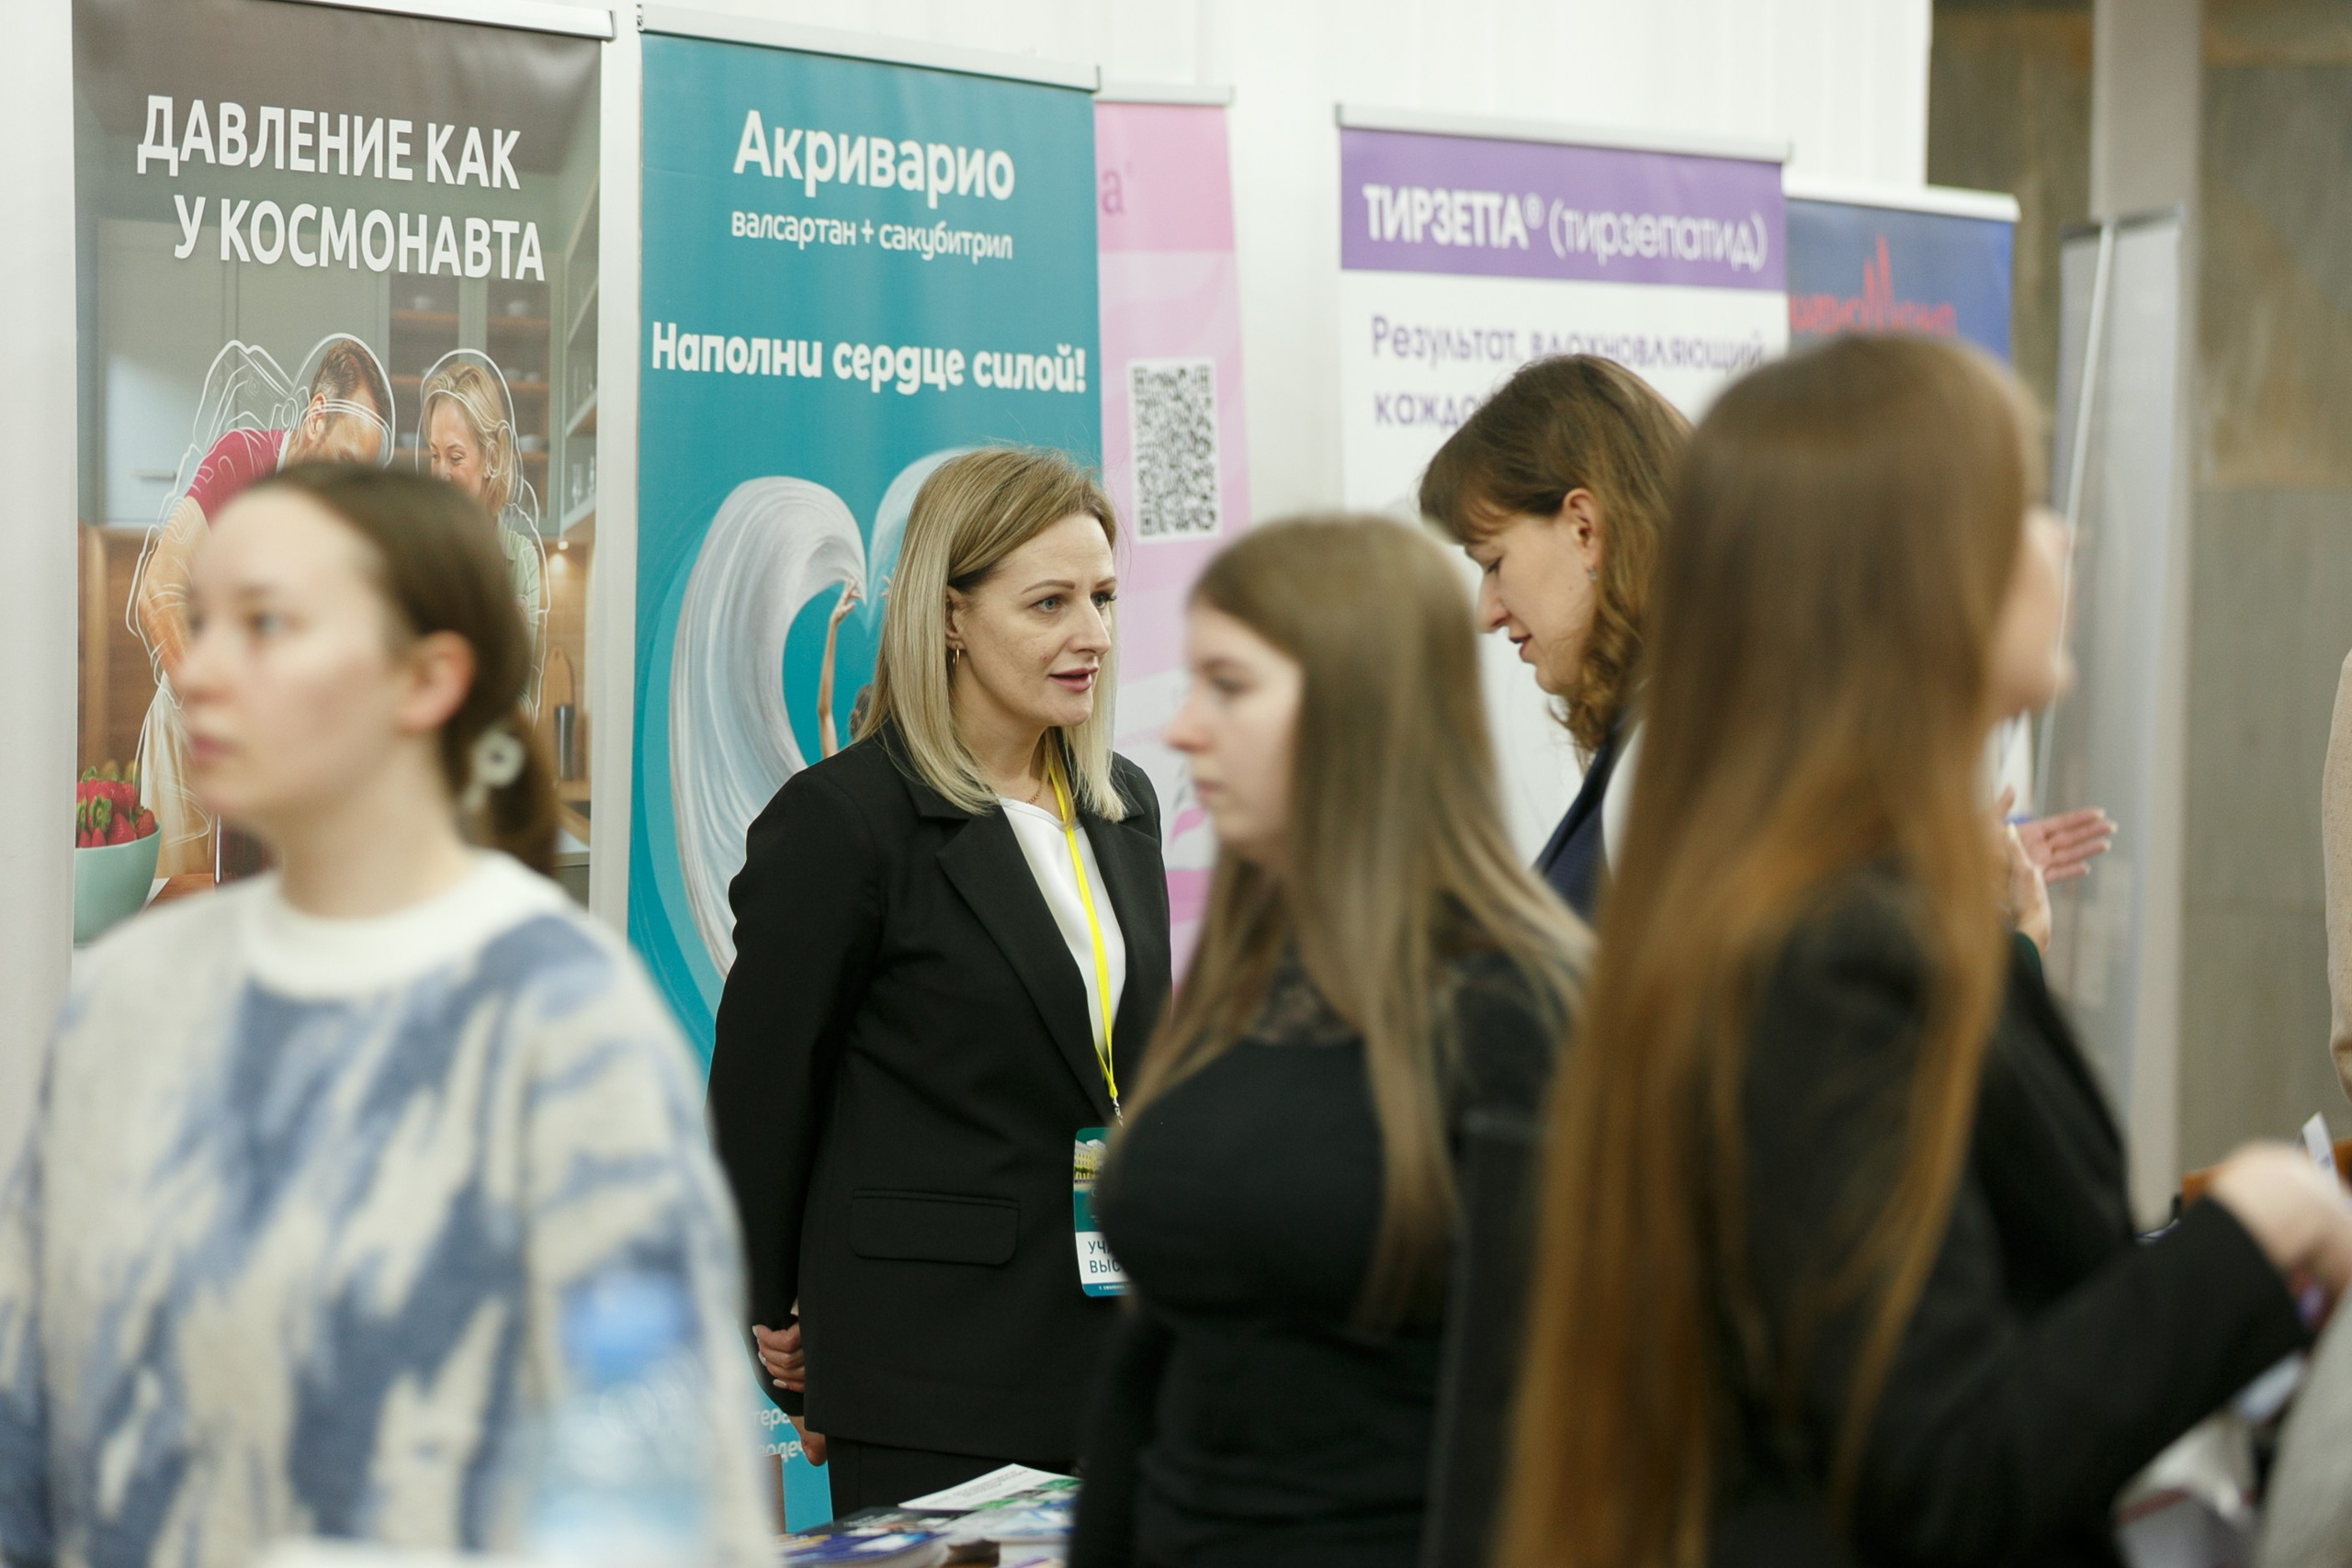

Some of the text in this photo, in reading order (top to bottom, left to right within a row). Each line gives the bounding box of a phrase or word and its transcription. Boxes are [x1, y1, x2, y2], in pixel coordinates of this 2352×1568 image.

[137, 95, 522, 190] ДАВЛЕНИЕ КАК
[733, 109, 1015, 209] Акриварио
[174, 194, 546, 281] У КОСМОНАВТА
[731, 210, 857, 251] валсартан
[879, 220, 1013, 265] сакубитрил
[1548, 197, 1768, 274] (тирзепатид)
[652, 321, 1087, 395] Наполни сердце силой!
[1374, 392, 1481, 432] каждо
[1088, 1240, 1109, 1255] УЧ
[1089, 1258, 1122, 1274] ВЫС
